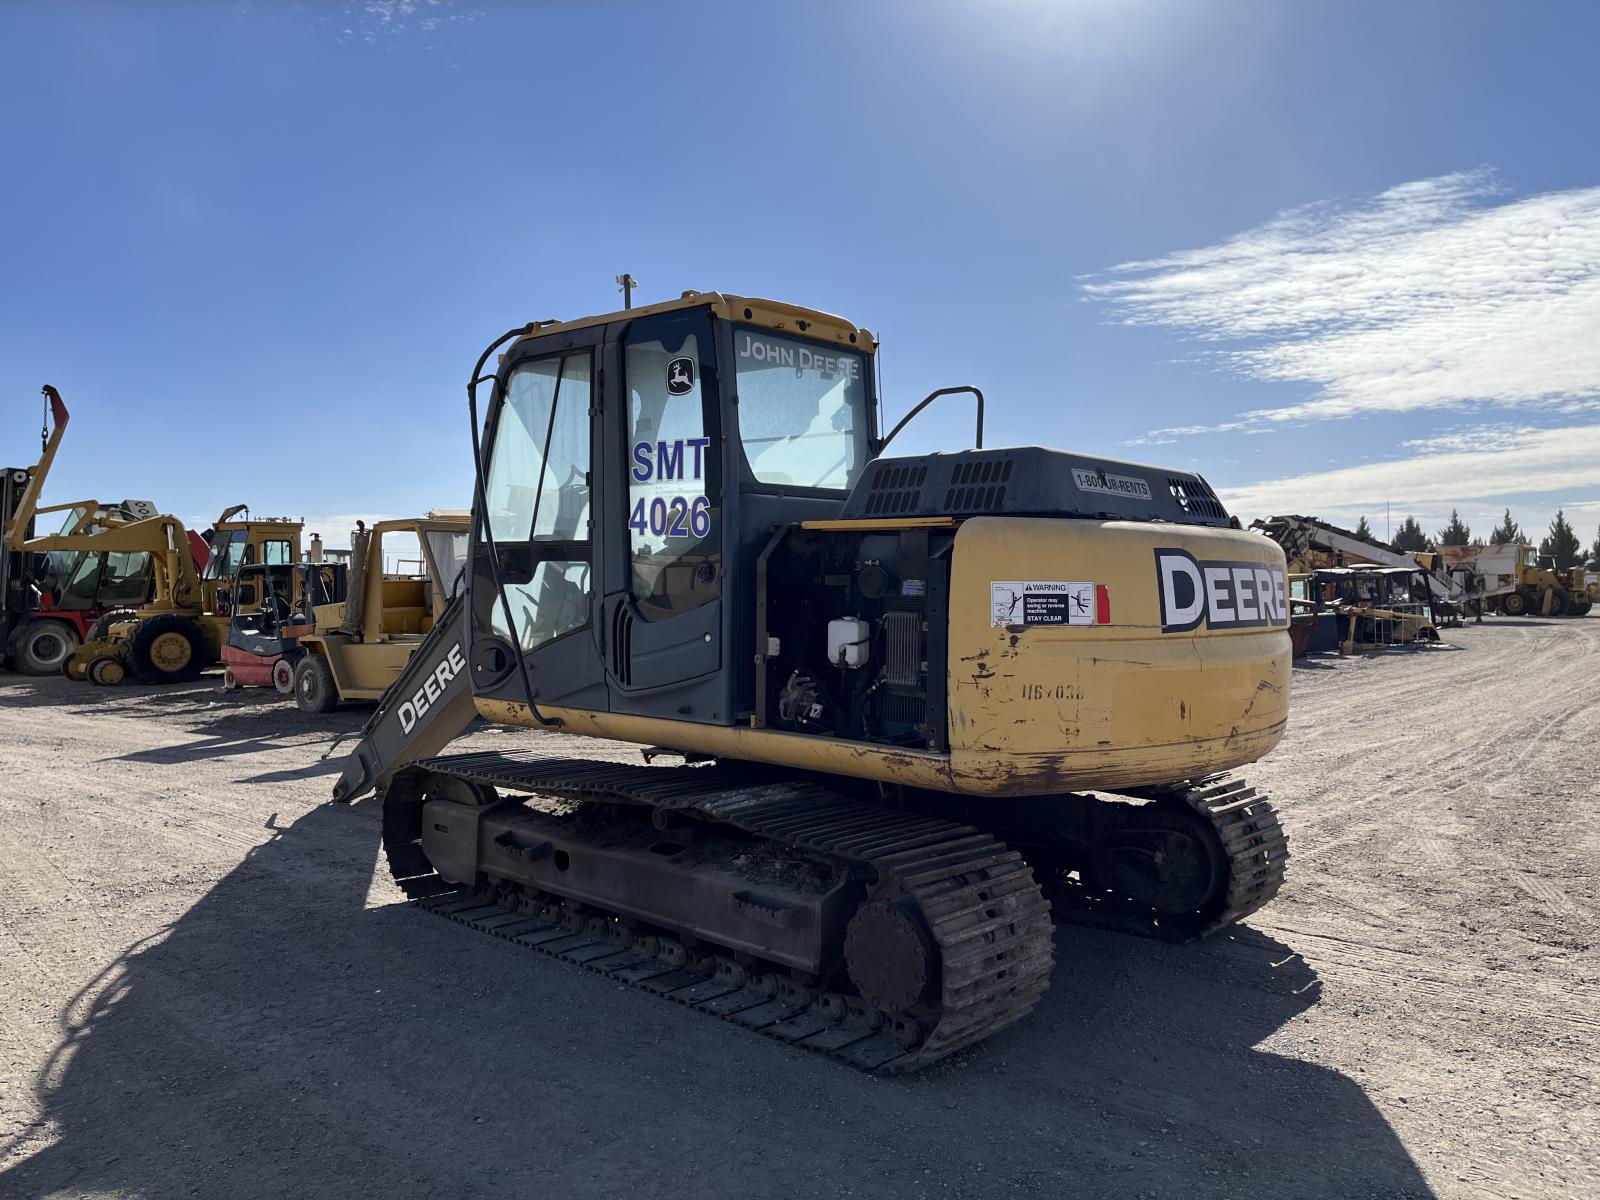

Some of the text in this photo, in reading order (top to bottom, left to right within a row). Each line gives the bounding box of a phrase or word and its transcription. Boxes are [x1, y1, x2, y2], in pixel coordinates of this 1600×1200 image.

[740, 336, 859, 380] JOHN DEERE
[632, 437, 710, 482] SMT
[1077, 474, 1148, 495] 1-800UR-RENTS
[629, 496, 710, 538] 4026
[1157, 552, 1287, 628] DEERE
[397, 642, 466, 735] DEERE
